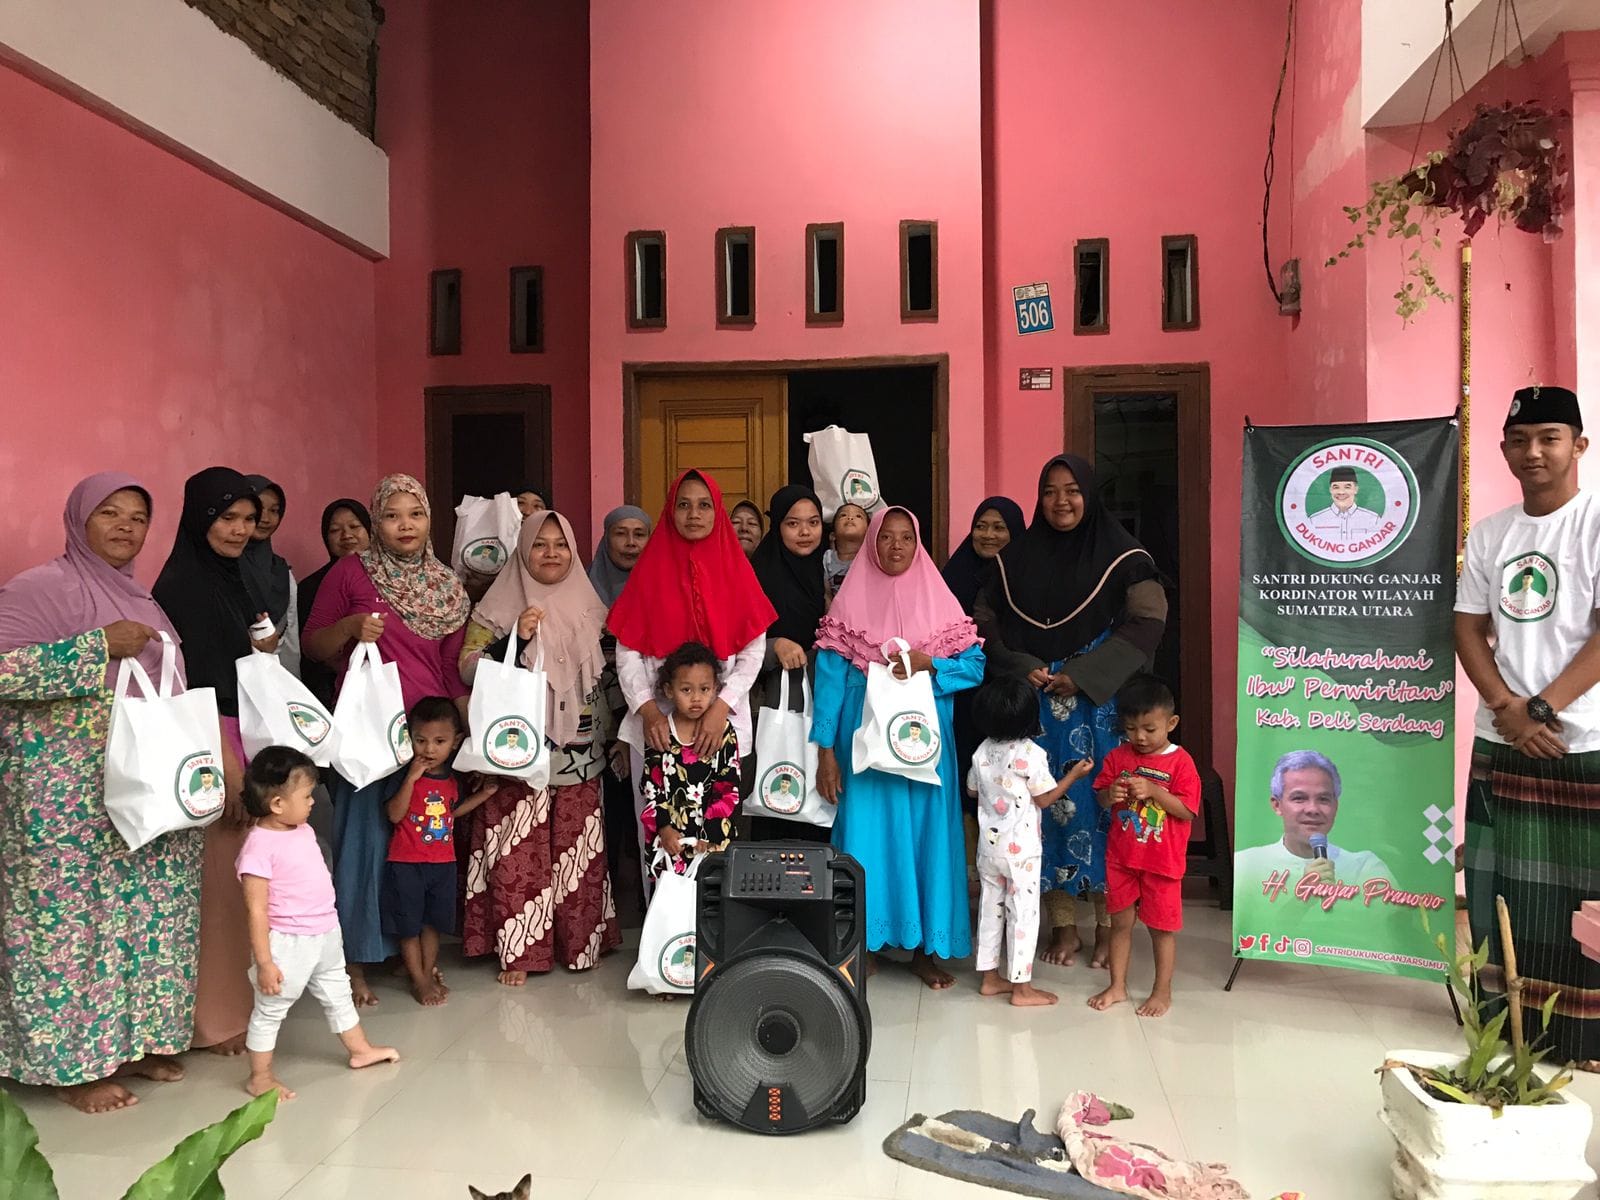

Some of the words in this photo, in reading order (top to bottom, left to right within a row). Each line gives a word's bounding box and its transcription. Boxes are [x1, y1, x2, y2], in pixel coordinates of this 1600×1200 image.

[1019, 301, 1048, 329] 506
[1312, 448, 1384, 470] SANTRI
[1296, 523, 1345, 553] DUKUNG
[1348, 521, 1396, 552] GANJAR
[1517, 557, 1548, 570] SANTRI
[1252, 574, 1305, 585] SANTRI
[1310, 574, 1374, 585] DUKUNG
[1378, 573, 1442, 585] GANJAR
[1259, 589, 1358, 601] KORDINATOR
[1362, 589, 1434, 601] WILAYAH
[1277, 605, 1358, 616] SUMATERA
[1362, 605, 1413, 617] UTARA
[1256, 709, 1300, 727] Kab.
[1309, 711, 1356, 729] Deli
[1358, 713, 1444, 738] Serdang
[1261, 869, 1290, 902] H.
[1294, 871, 1360, 912] Ganjar
